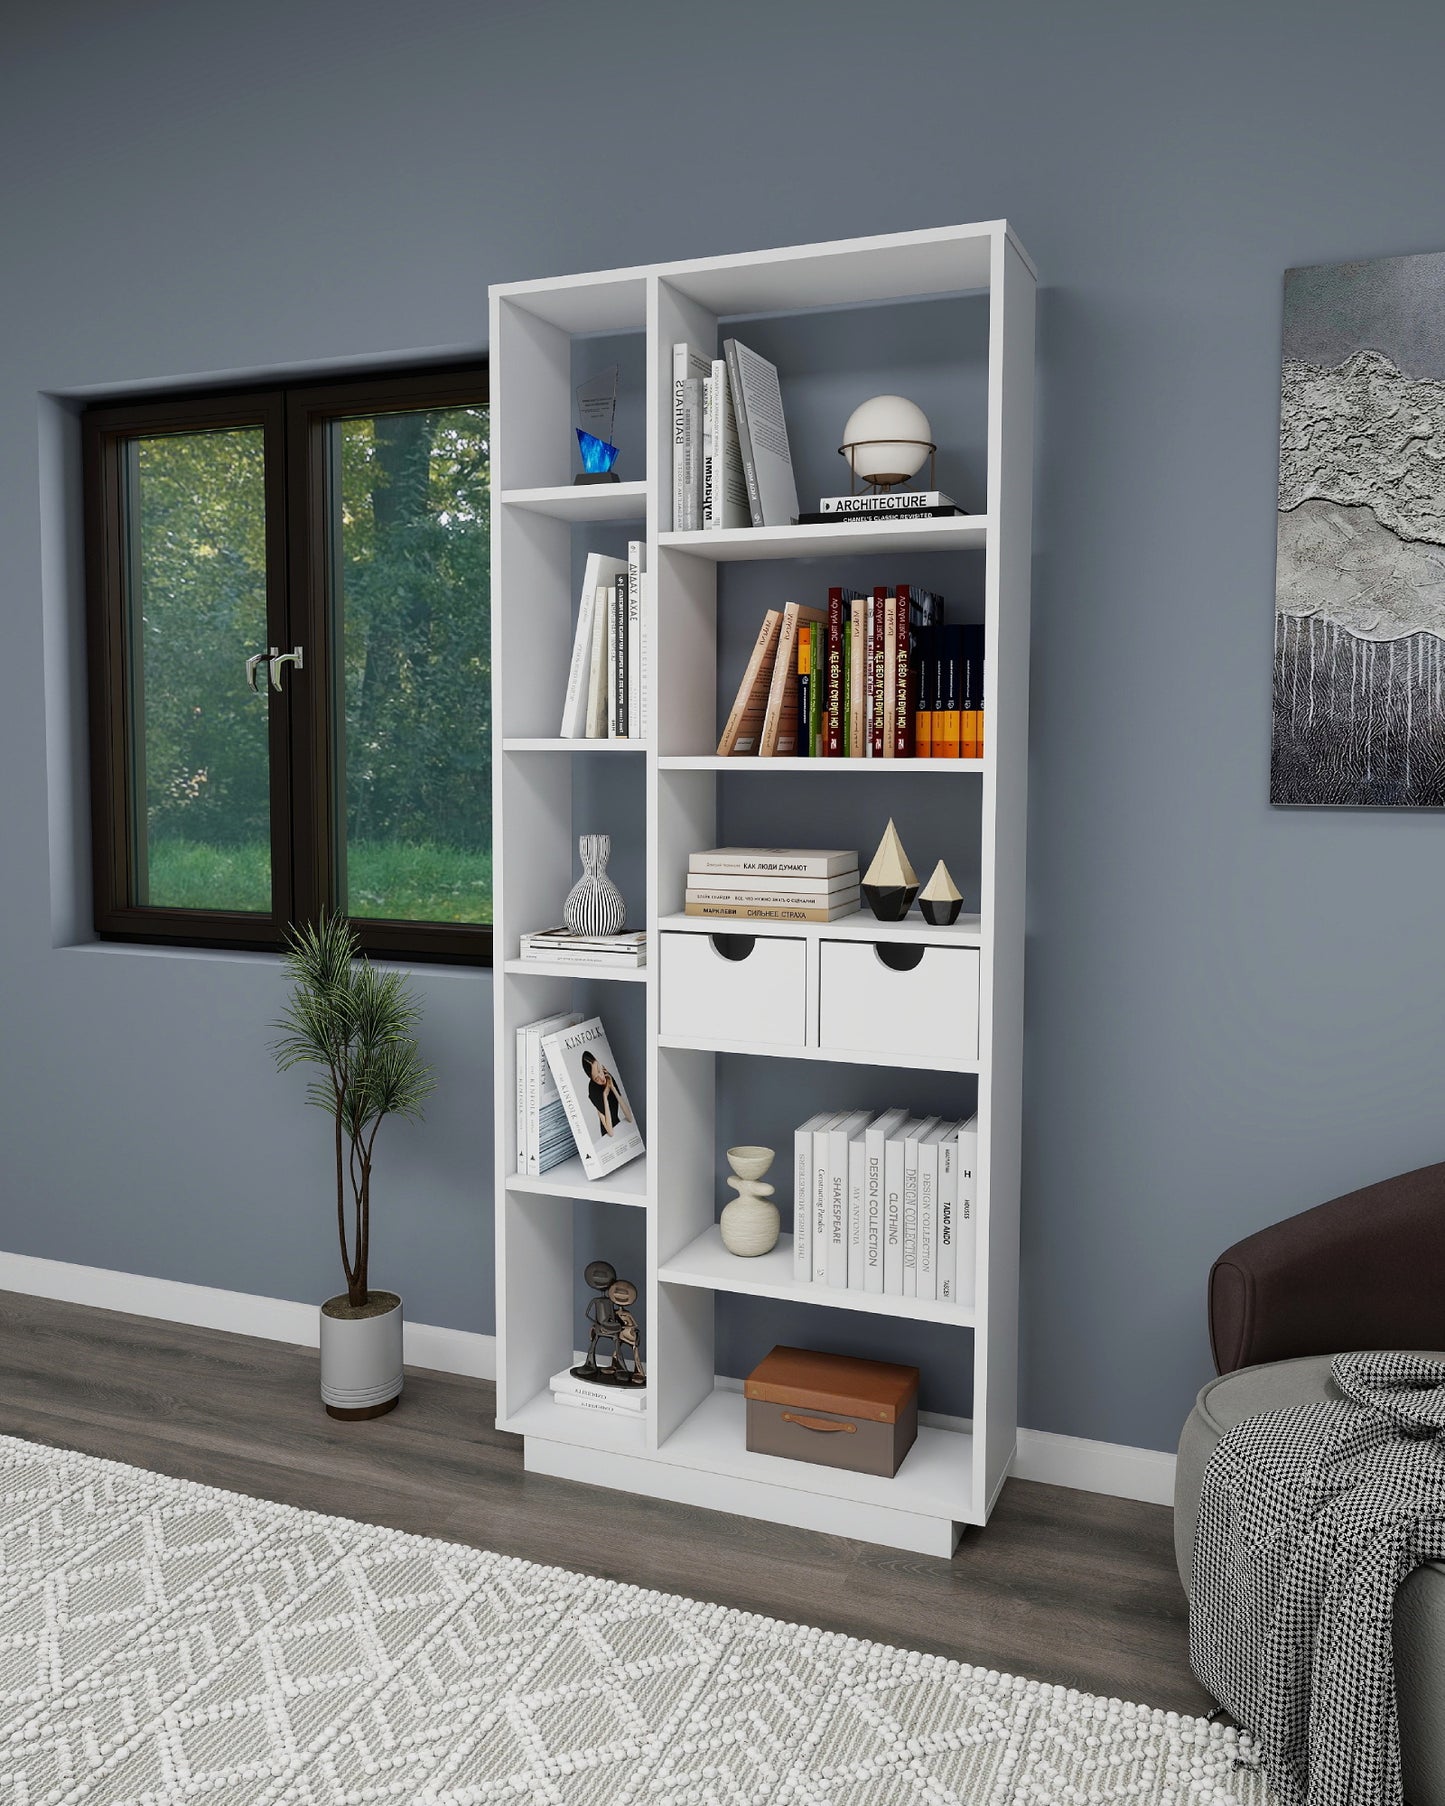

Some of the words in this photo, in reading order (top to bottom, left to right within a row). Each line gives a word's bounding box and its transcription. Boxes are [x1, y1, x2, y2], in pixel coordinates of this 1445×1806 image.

[836, 495, 927, 512] ARCHITECTURE
[564, 1026, 603, 1050] KINFOLK
[560, 1086, 577, 1120] KINFOLK
[816, 1168, 826, 1208] Constructing
[852, 1186, 860, 1201] MY
[870, 1157, 878, 1197] DESIGN
[906, 1168, 916, 1205] DESIGN
[922, 1173, 931, 1210] DESIGN
[832, 1177, 842, 1244] SHAKESPEARE
[888, 1192, 898, 1245] CLOTHING
[868, 1200, 878, 1267] COLLECTION
[904, 1208, 916, 1269] COLLECTION
[922, 1212, 930, 1272] COLLECTION
